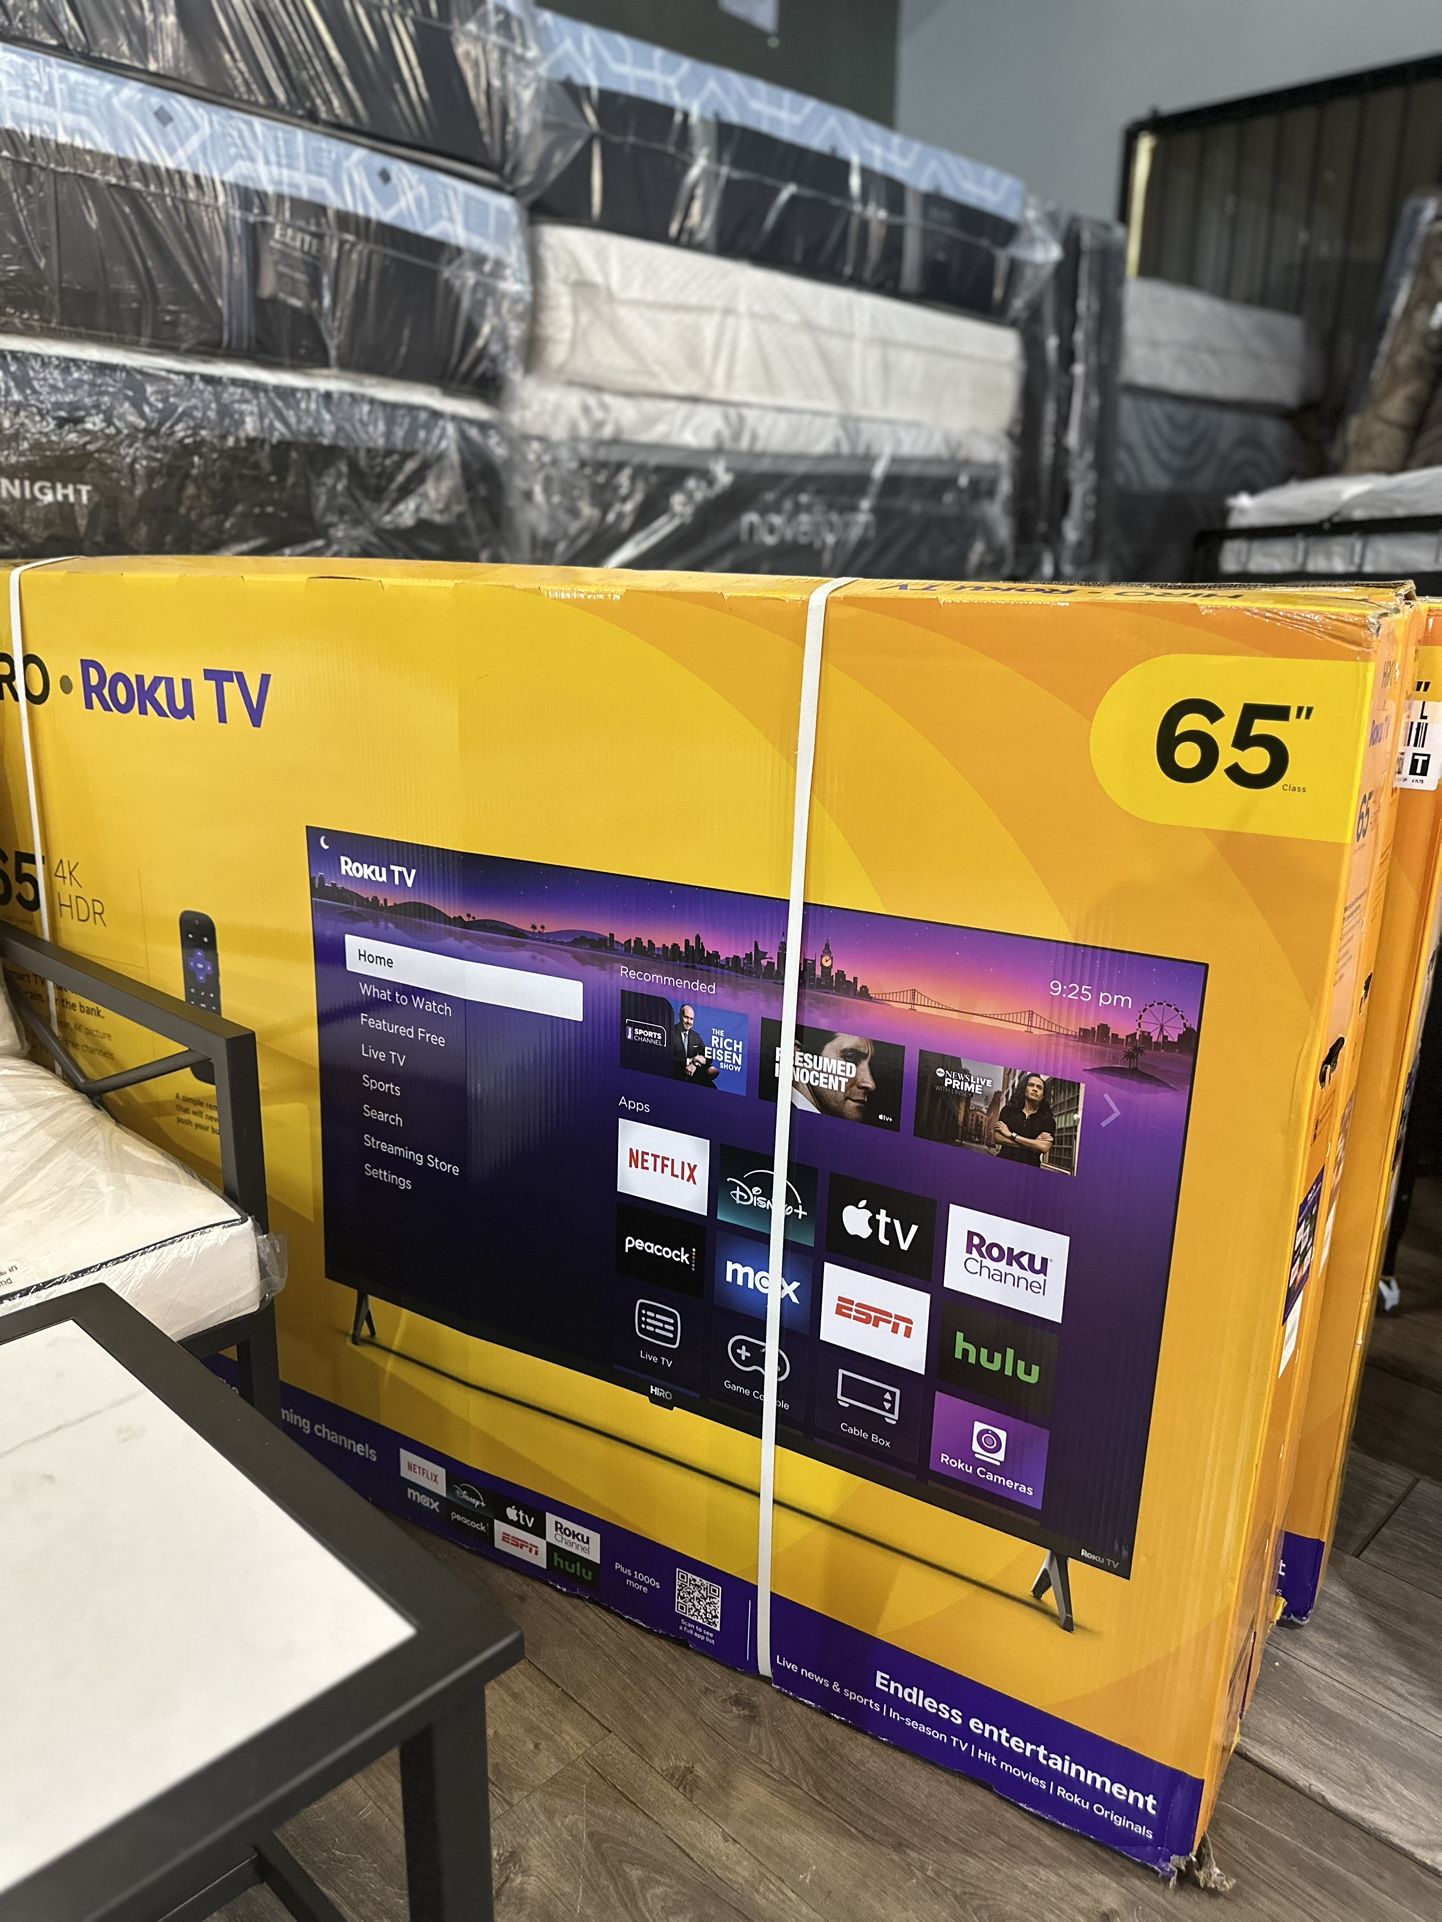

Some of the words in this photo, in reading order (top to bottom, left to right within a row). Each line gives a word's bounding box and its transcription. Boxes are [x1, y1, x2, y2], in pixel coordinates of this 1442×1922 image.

[80, 658, 195, 721] Roku
[203, 668, 272, 729] TV
[1155, 697, 1314, 790] 65"
[1282, 783, 1307, 793] Class
[54, 859, 83, 888] 4K
[340, 856, 387, 883] Roku
[390, 865, 416, 887] TV
[57, 891, 107, 928] HDR
[358, 949, 394, 968] Home
[620, 966, 716, 994] Recommended
[359, 982, 392, 1003] What
[395, 991, 408, 1005] to
[411, 995, 452, 1016] Watch
[1049, 980, 1092, 1001] 9:25
[1099, 991, 1132, 1009] pm
[79, 1001, 105, 1019] bank.
[360, 1013, 414, 1039] Featured
[418, 1027, 446, 1047] Free
[634, 1028, 662, 1040] SPORTS
[634, 1035, 663, 1047] CHANNEL
[712, 1028, 725, 1037] THE
[361, 1044, 386, 1062] Live
[389, 1051, 406, 1067] TV
[704, 1047, 743, 1065] EISEN
[711, 1036, 743, 1053] RICH
[720, 1062, 742, 1072] SHOW
[775, 1047, 857, 1078] ESUMED
[362, 1075, 401, 1096] Sports
[774, 1063, 849, 1093] INOCENT
[944, 1078, 983, 1094] PRIME
[363, 1105, 403, 1127] Search
[618, 1096, 650, 1113] Apps
[195, 1122, 209, 1131] your
[363, 1134, 424, 1165] Streaming
[427, 1153, 460, 1176] Store
[628, 1148, 698, 1185] NETFLIX
[364, 1163, 412, 1190] Settings
[876, 1207, 919, 1251] tv
[625, 1236, 690, 1265] peacock
[965, 1229, 1050, 1278] Roku
[964, 1257, 1048, 1296] Channel
[835, 1296, 914, 1339] ESPN
[640, 1350, 658, 1364] Live
[660, 1356, 673, 1368] TV
[954, 1331, 1041, 1384] hulu
[650, 1385, 673, 1400] HIRO
[724, 1380, 750, 1396] Game
[752, 1390, 790, 1411] Coole
[314, 1424, 377, 1462] channels
[840, 1422, 868, 1441] Cable
[871, 1433, 891, 1449] Box
[407, 1461, 439, 1485] NETFLIX
[940, 1453, 973, 1474] Roku
[976, 1467, 1034, 1496] Cameras
[407, 1487, 441, 1513] max
[450, 1511, 486, 1532] peacock
[519, 1512, 535, 1528] tv
[554, 1520, 590, 1546] Roku
[501, 1531, 539, 1556] ESPN
[554, 1533, 591, 1555] Channel
[553, 1552, 592, 1582] hulu
[1081, 1548, 1104, 1564] Roku
[1106, 1558, 1120, 1568] TV
[614, 1562, 632, 1577] Plus
[633, 1570, 661, 1589] 1000s
[626, 1578, 648, 1594] more
[681, 1619, 694, 1629] Scan
[694, 1632, 705, 1640] app
[776, 1654, 798, 1672] Live
[800, 1667, 830, 1688] news
[832, 1679, 842, 1694] &
[843, 1685, 880, 1712] sports
[889, 1707, 948, 1744] In-season
[950, 1734, 969, 1752] TV
[977, 1748, 998, 1766] Hit
[1000, 1760, 1047, 1790] movies
[1057, 1785, 1091, 1811] Roku
[1093, 1802, 1154, 1840] Originals
[875, 1670, 963, 1725] Endless
[968, 1716, 1158, 1815] entertainment
